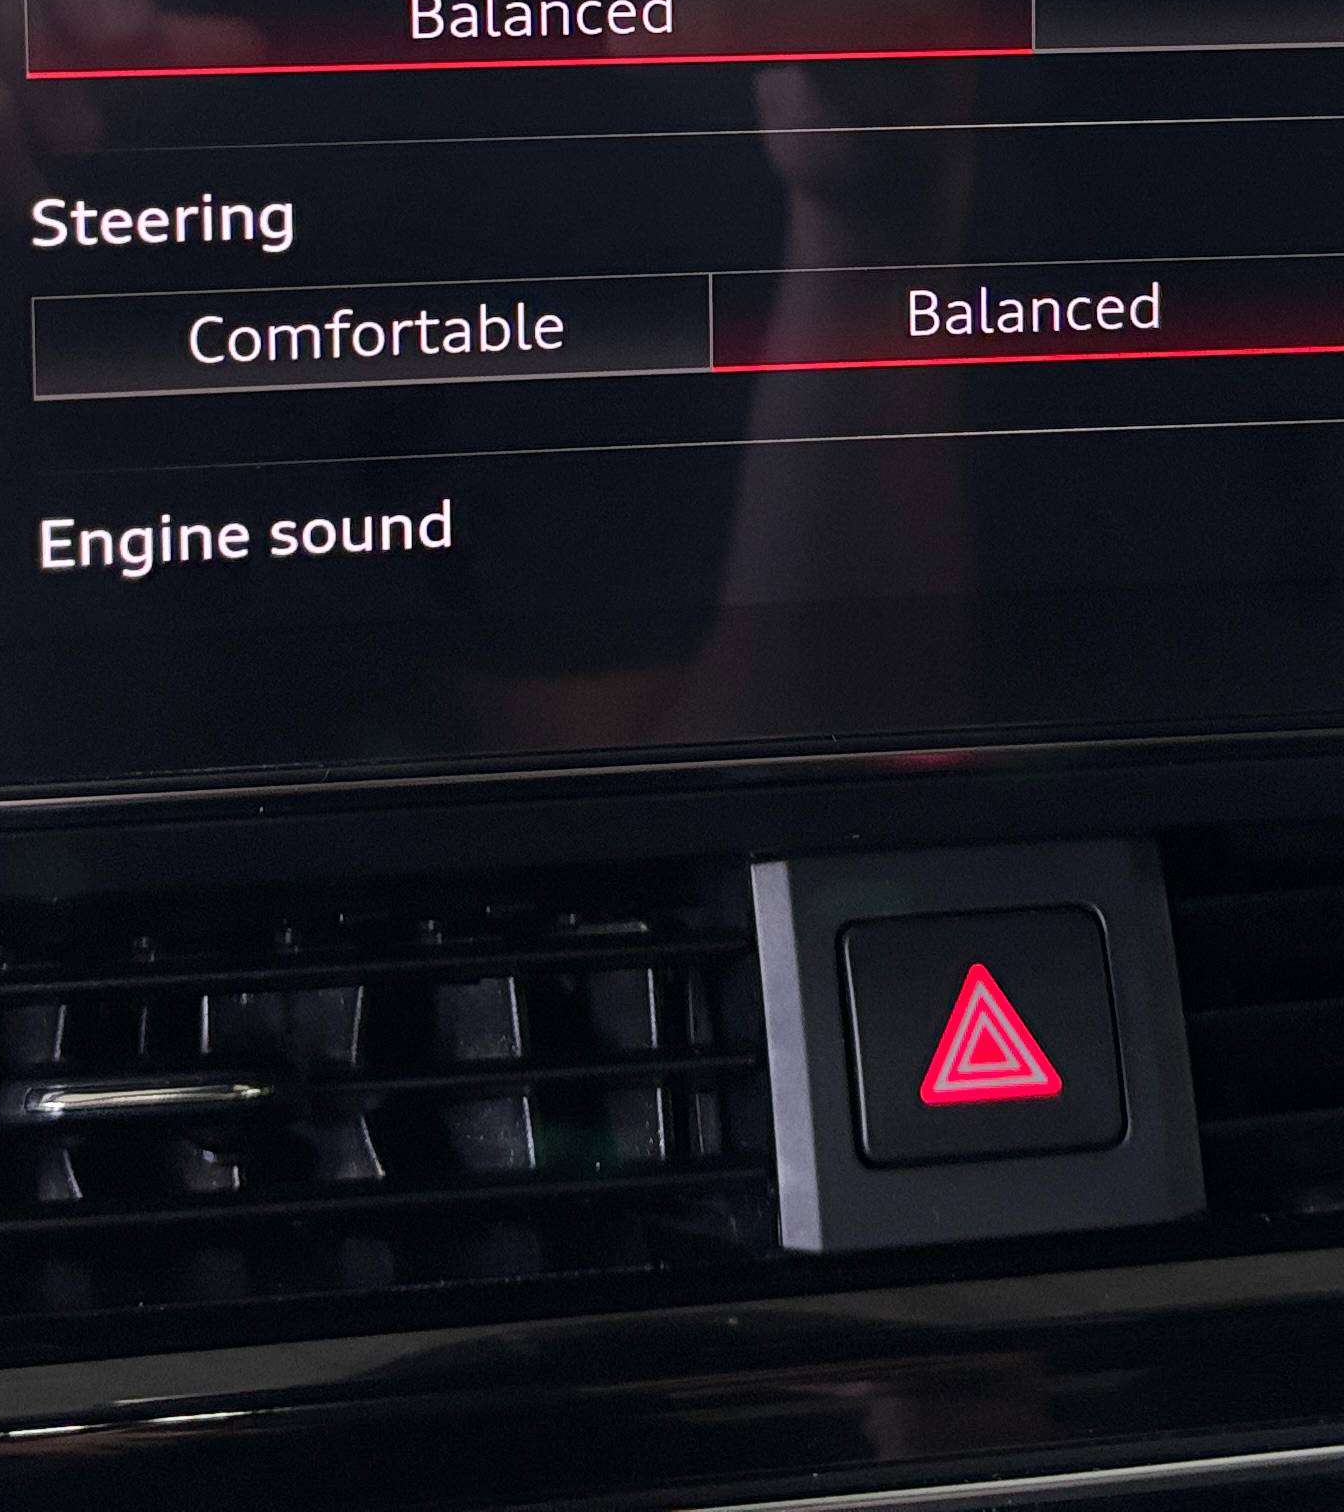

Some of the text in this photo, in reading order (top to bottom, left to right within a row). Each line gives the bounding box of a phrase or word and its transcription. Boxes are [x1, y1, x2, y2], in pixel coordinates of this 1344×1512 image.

[31, 194, 294, 253] Steering
[188, 303, 565, 363] Comfortable
[908, 282, 1161, 337] Balanced
[40, 498, 452, 578] Engine sound
